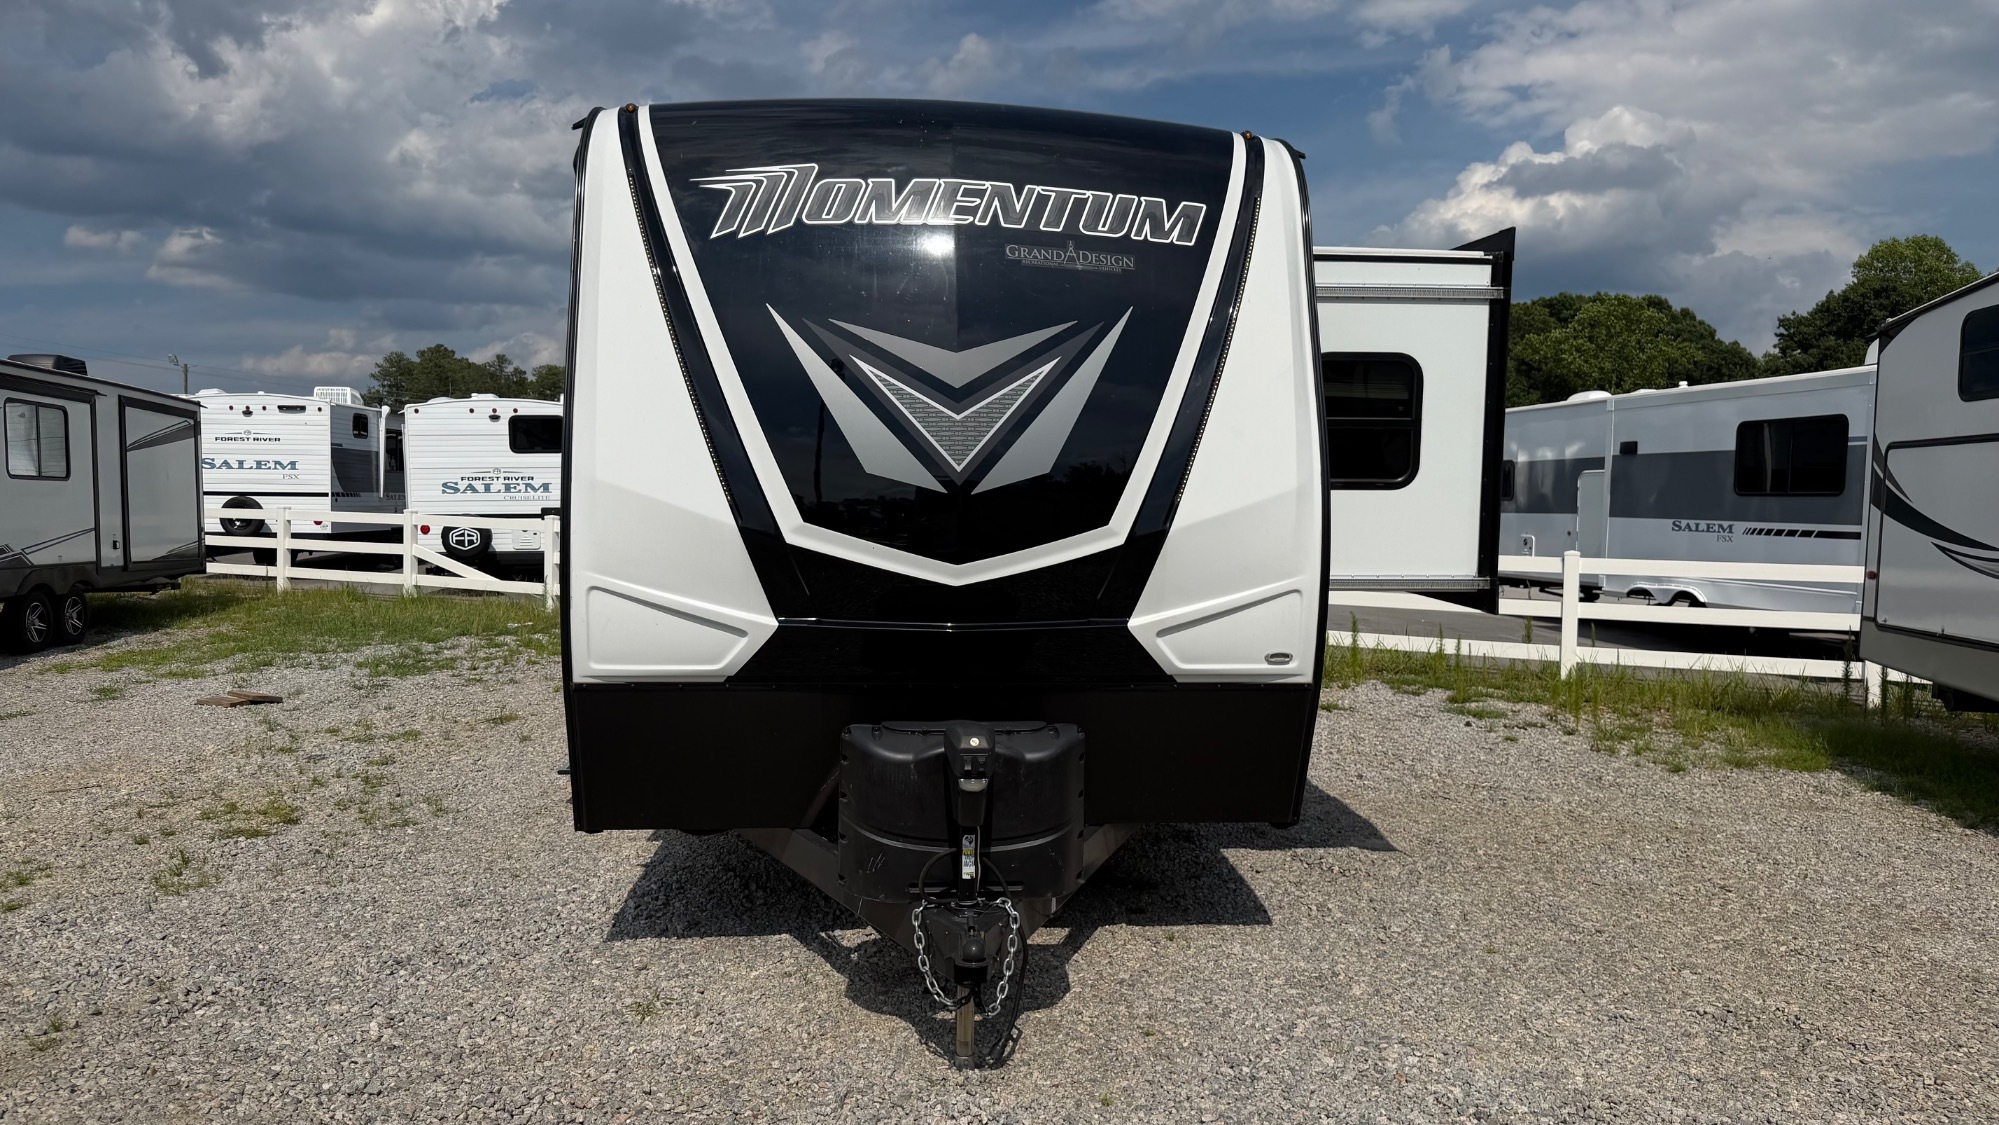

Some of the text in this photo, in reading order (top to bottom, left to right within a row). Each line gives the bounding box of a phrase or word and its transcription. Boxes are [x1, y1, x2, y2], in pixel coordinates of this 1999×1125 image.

[689, 163, 1207, 246] MOMENTUM
[1006, 244, 1134, 268] GRAND DESIGN
[202, 457, 299, 470] SALEM
[441, 481, 552, 494] SALEM
[1672, 520, 1734, 534] SALEM
[1717, 535, 1734, 543] FSX
